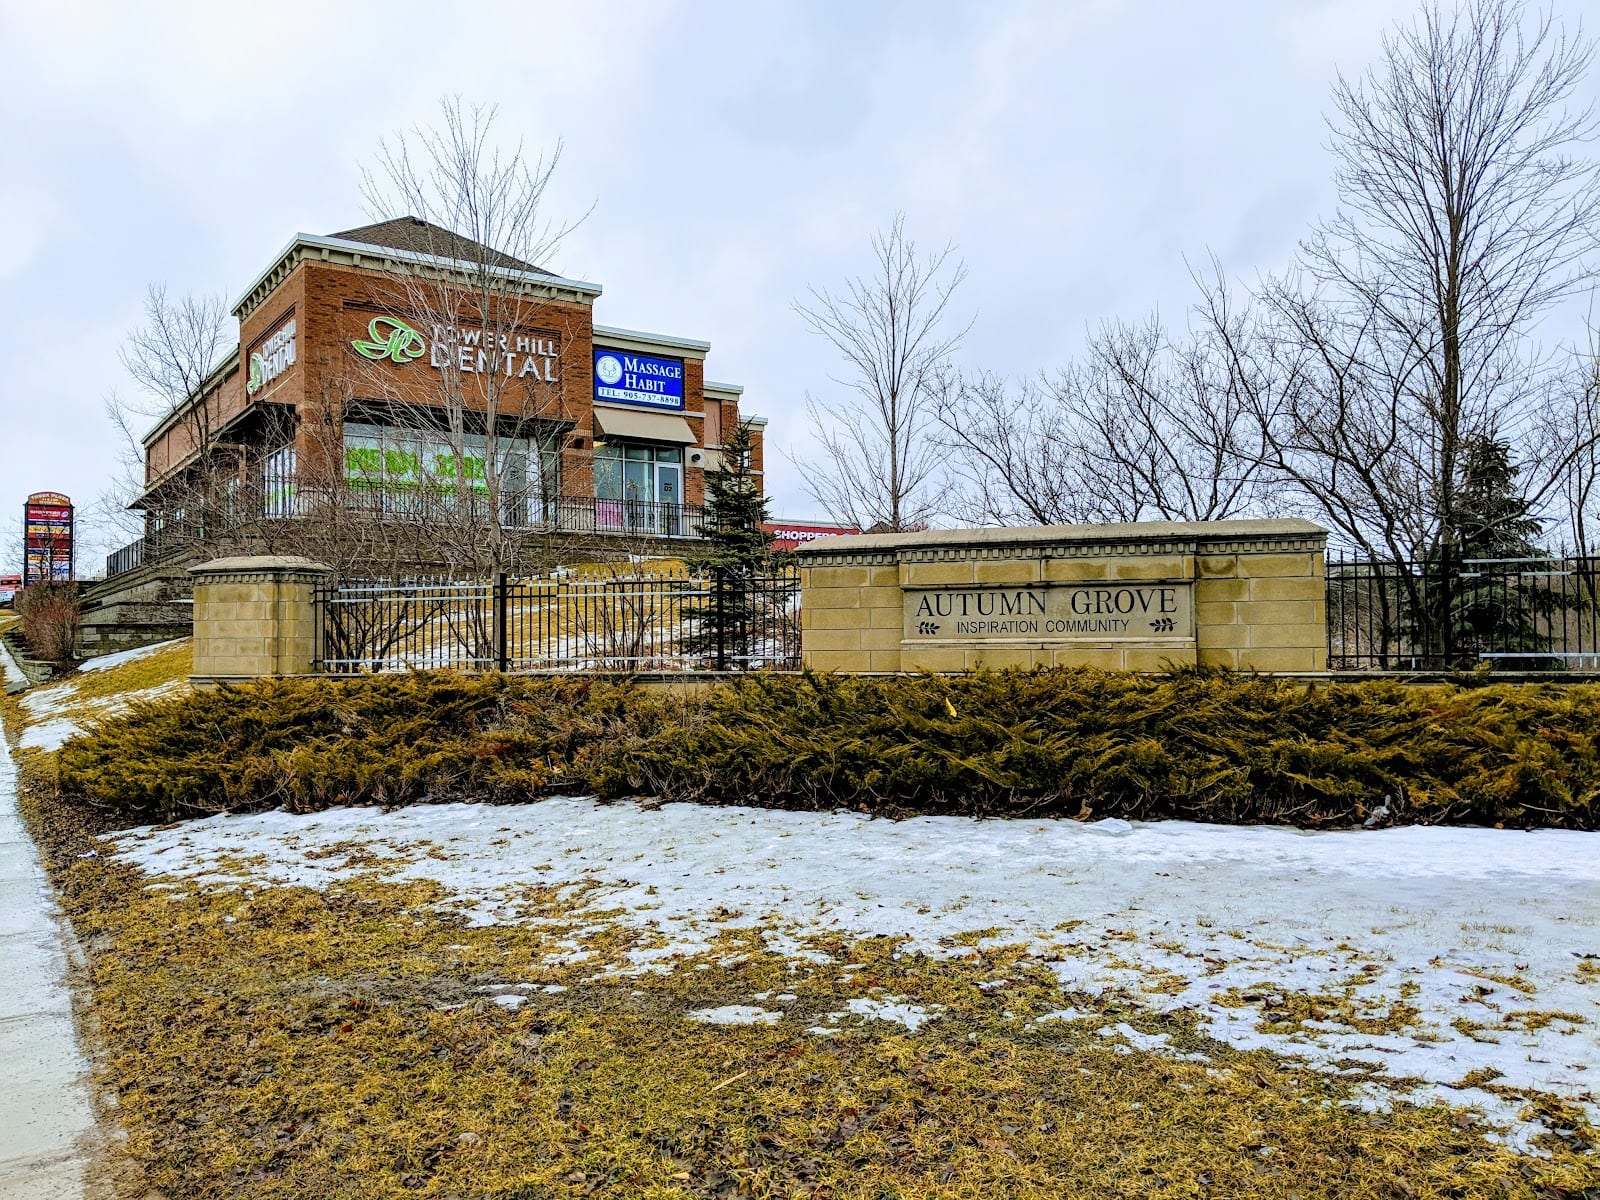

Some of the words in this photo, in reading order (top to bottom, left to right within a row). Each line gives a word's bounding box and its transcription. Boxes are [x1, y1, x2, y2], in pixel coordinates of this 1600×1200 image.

[516, 336, 558, 357] HILL
[430, 343, 559, 382] DENTAL
[915, 591, 1047, 617] AUTUMN
[1071, 588, 1178, 615] GROVE
[957, 620, 1038, 634] INSPIRATION
[1045, 618, 1130, 633] COMMUNITY
